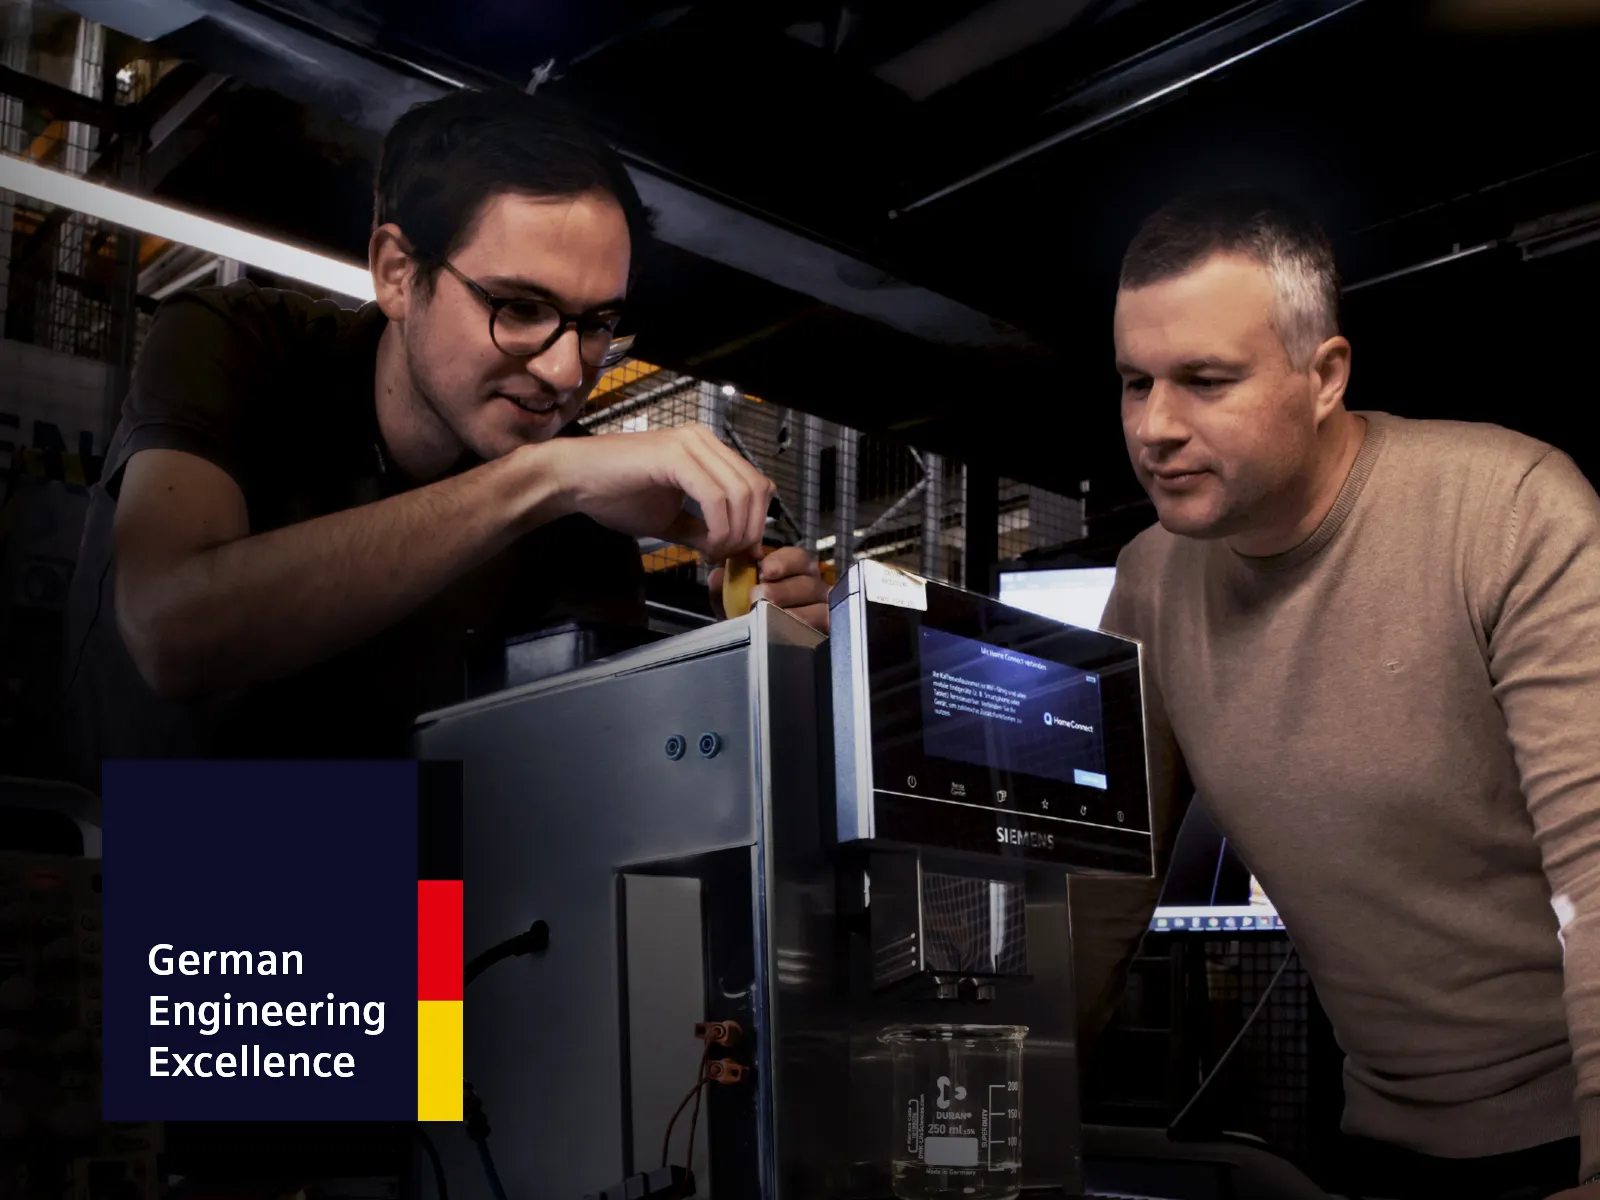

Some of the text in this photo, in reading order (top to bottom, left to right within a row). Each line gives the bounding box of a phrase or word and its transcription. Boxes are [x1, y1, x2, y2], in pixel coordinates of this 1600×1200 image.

[989, 649, 1004, 660] Home
[1004, 653, 1024, 665] Connect
[996, 826, 1054, 850] SIEMENS
[1008, 1081, 1018, 1091] 200
[1008, 1109, 1018, 1119] 150
[928, 1123, 946, 1134] 250
[948, 1124, 963, 1135] ml
[1008, 1137, 1018, 1146] 100
[949, 1169, 977, 1177] Germany
